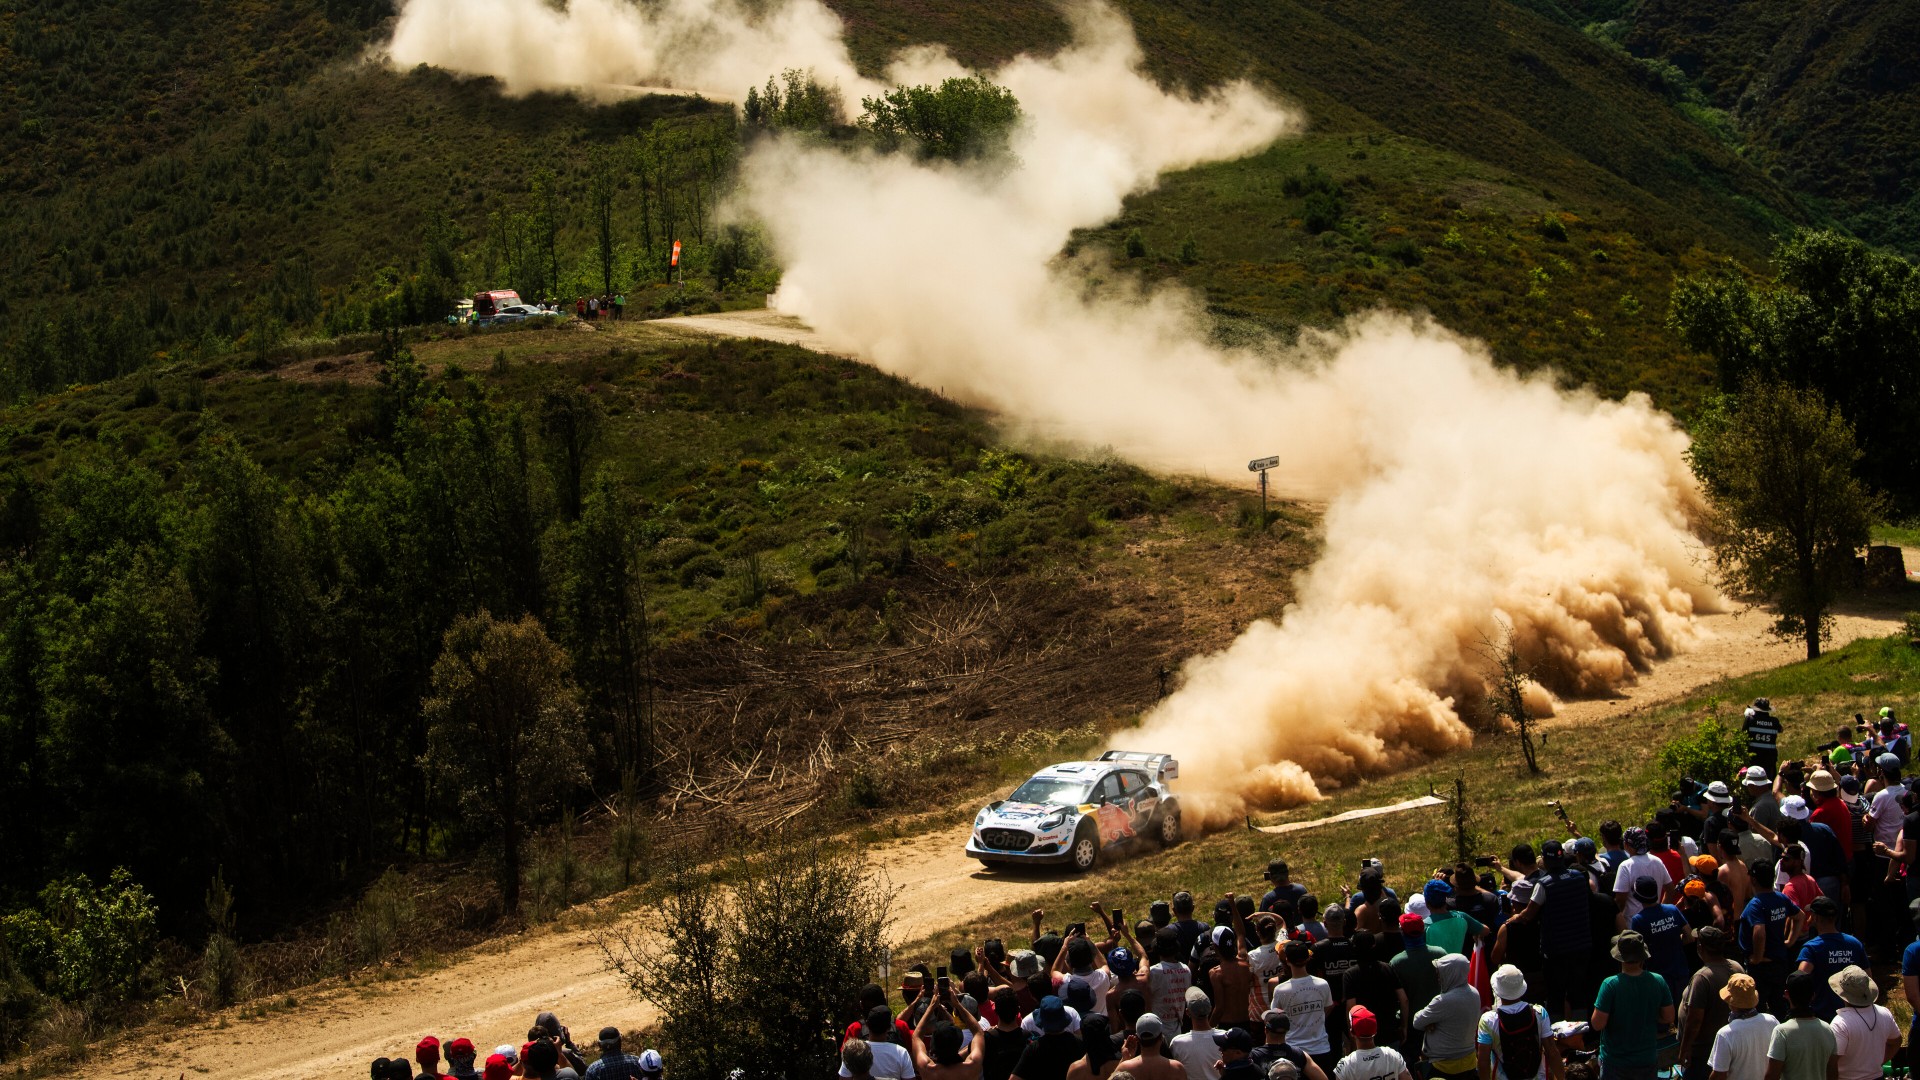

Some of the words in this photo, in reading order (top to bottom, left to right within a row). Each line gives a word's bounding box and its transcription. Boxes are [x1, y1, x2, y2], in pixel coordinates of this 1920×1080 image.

[1756, 733, 1770, 742] 645
[984, 834, 1030, 848] FORD
[1292, 1003, 1321, 1014] SUPRA
